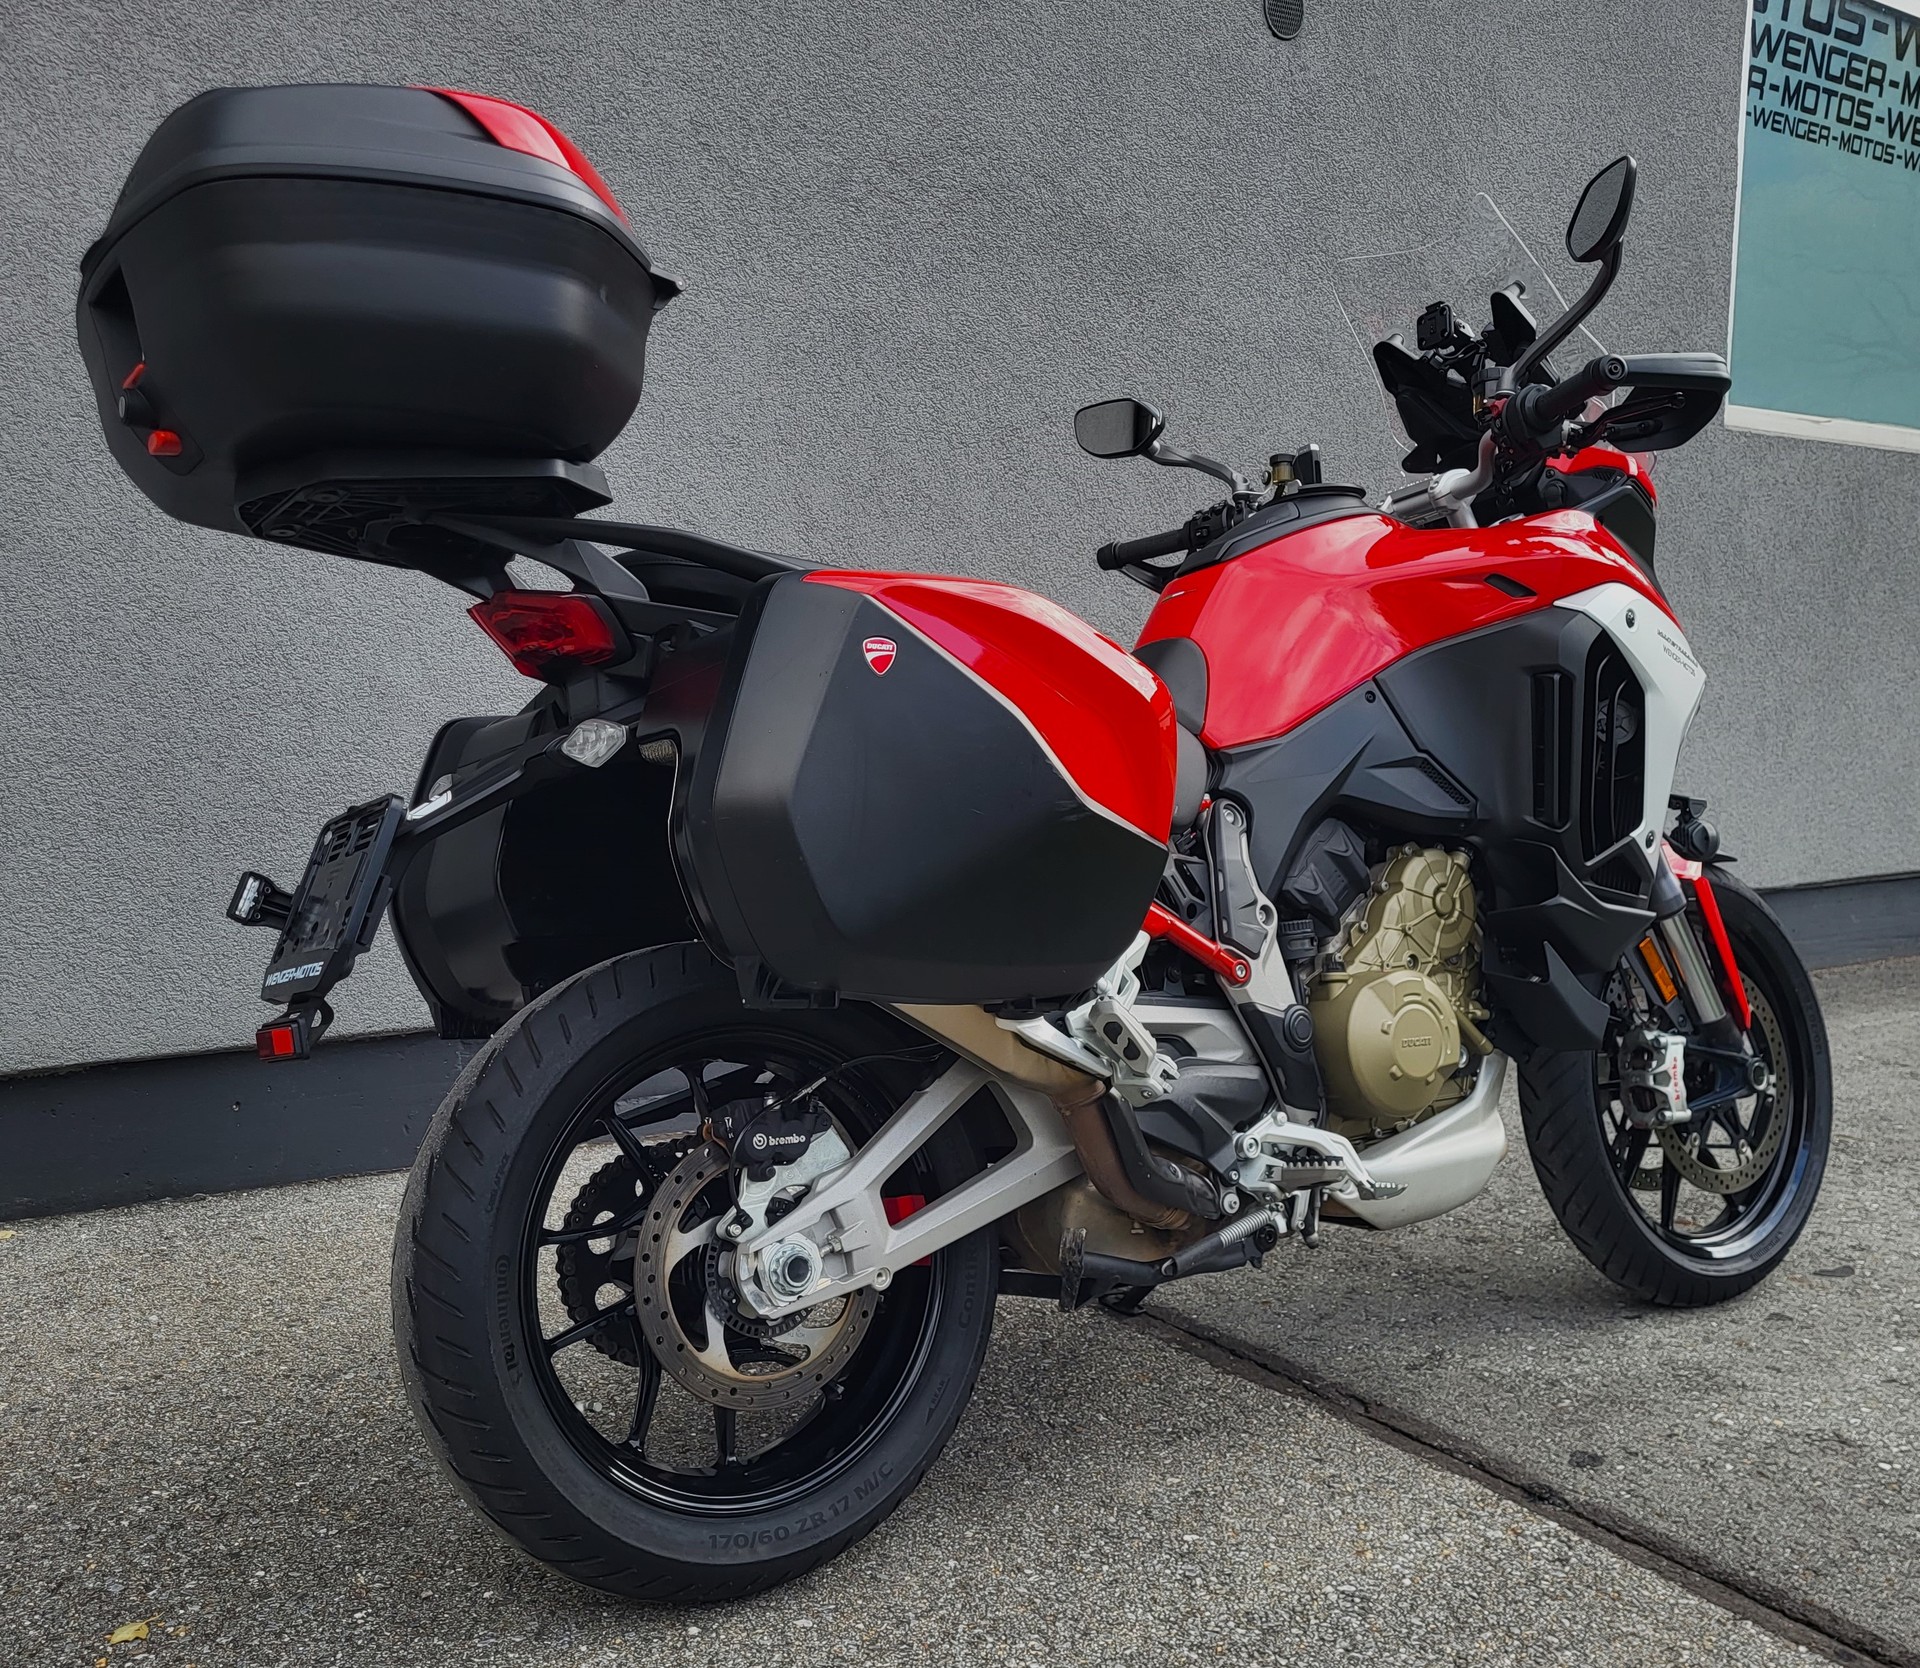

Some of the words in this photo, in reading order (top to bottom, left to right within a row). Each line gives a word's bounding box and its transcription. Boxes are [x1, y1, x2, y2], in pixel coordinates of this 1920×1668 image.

[866, 642, 894, 651] DUCATI
[1401, 1036, 1432, 1049] DUCATI
[768, 1134, 806, 1147] brembo
[708, 1525, 790, 1549] 170/60
[794, 1510, 827, 1535] ZR
[828, 1495, 851, 1518] 17
[853, 1461, 894, 1500] M/C
